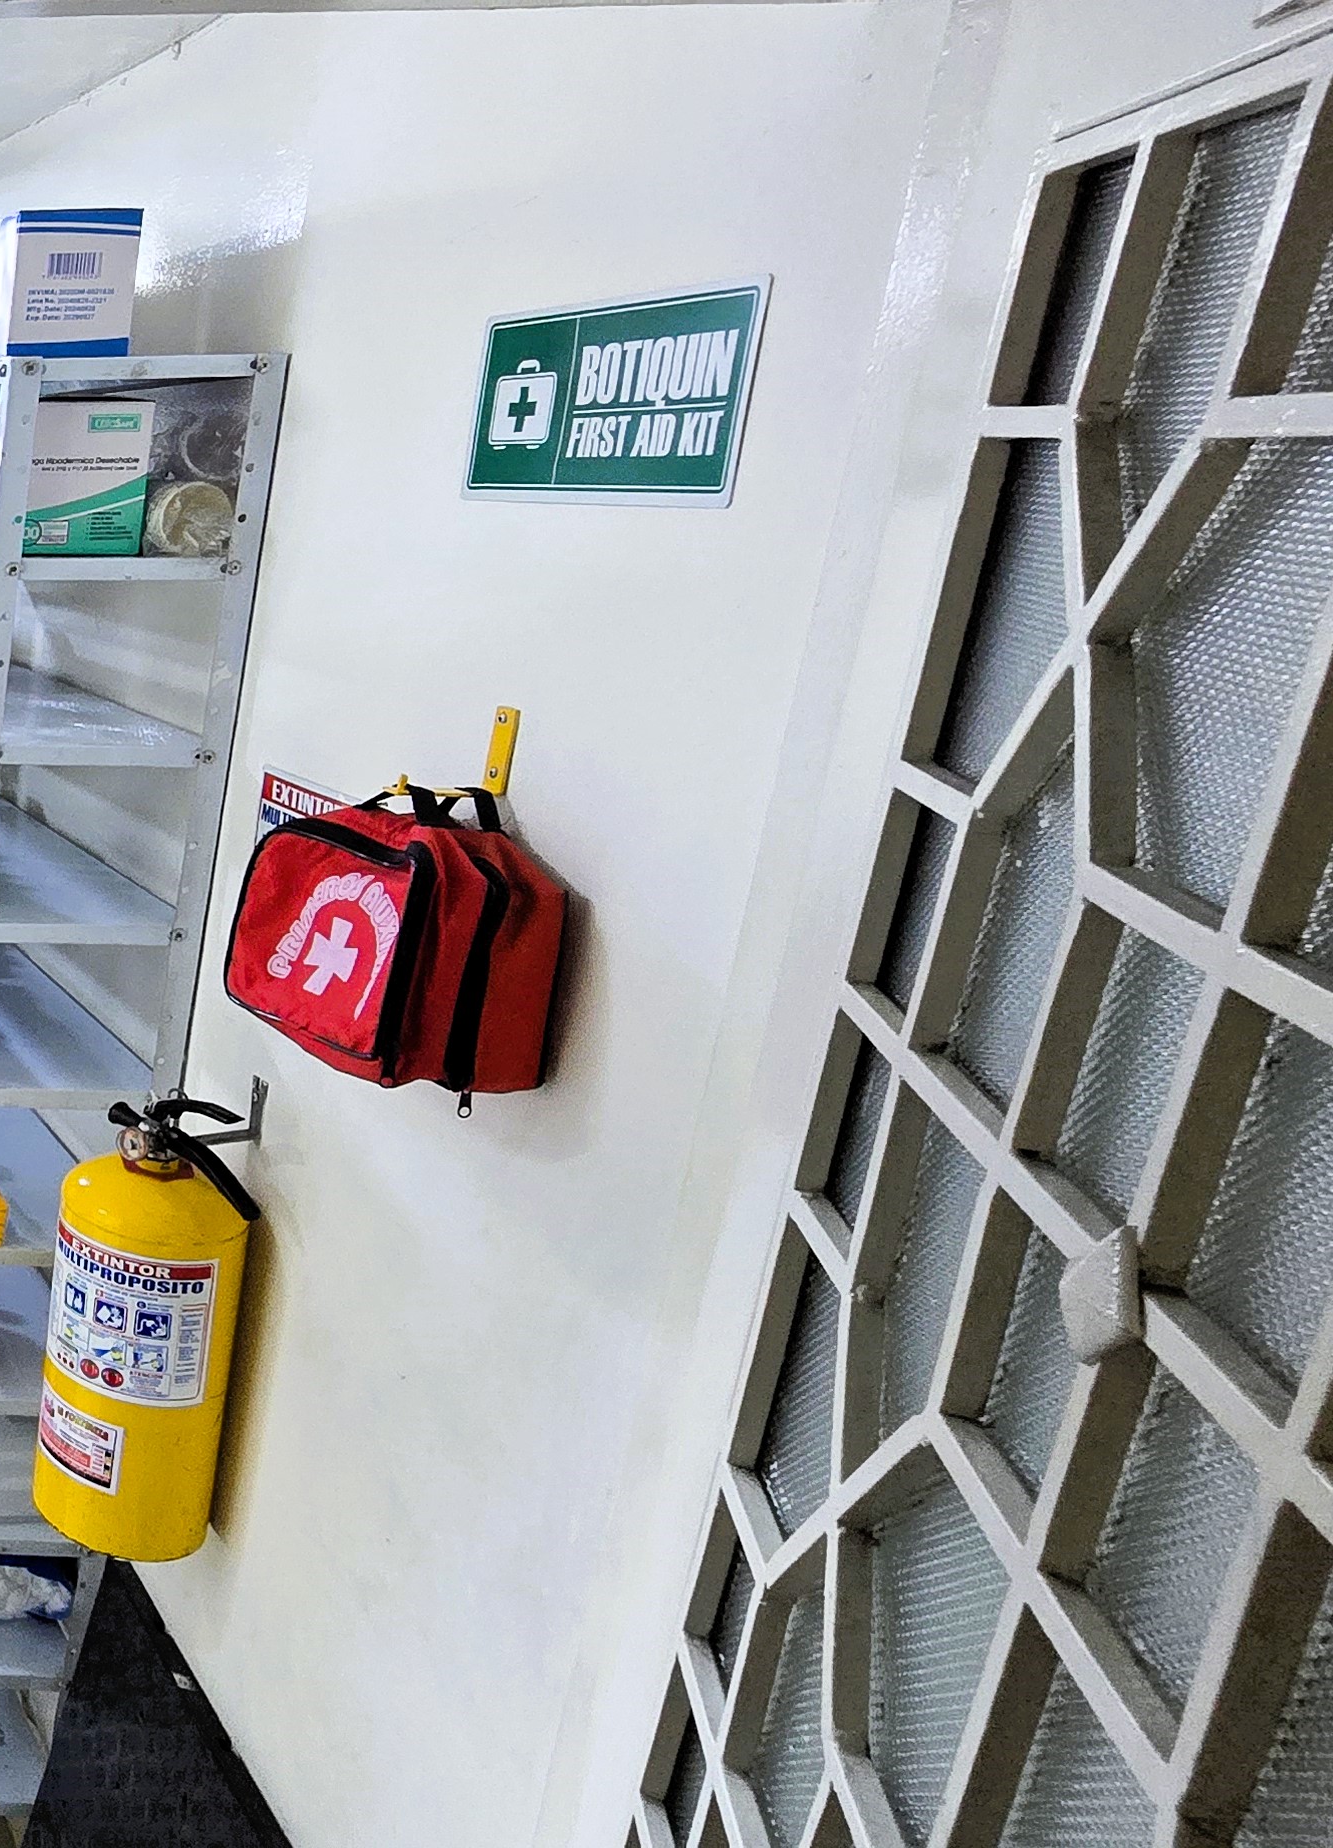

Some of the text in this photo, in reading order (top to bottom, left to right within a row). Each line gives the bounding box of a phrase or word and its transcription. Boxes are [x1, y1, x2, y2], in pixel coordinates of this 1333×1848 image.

[574, 328, 740, 407] BOTIQUIN
[565, 411, 725, 459] FIRST AID KIT
[271, 779, 345, 817] EXTINTO
[58, 1236, 205, 1295] MULTIPROPOSITO
[71, 1238, 171, 1279] EXTINTOR
